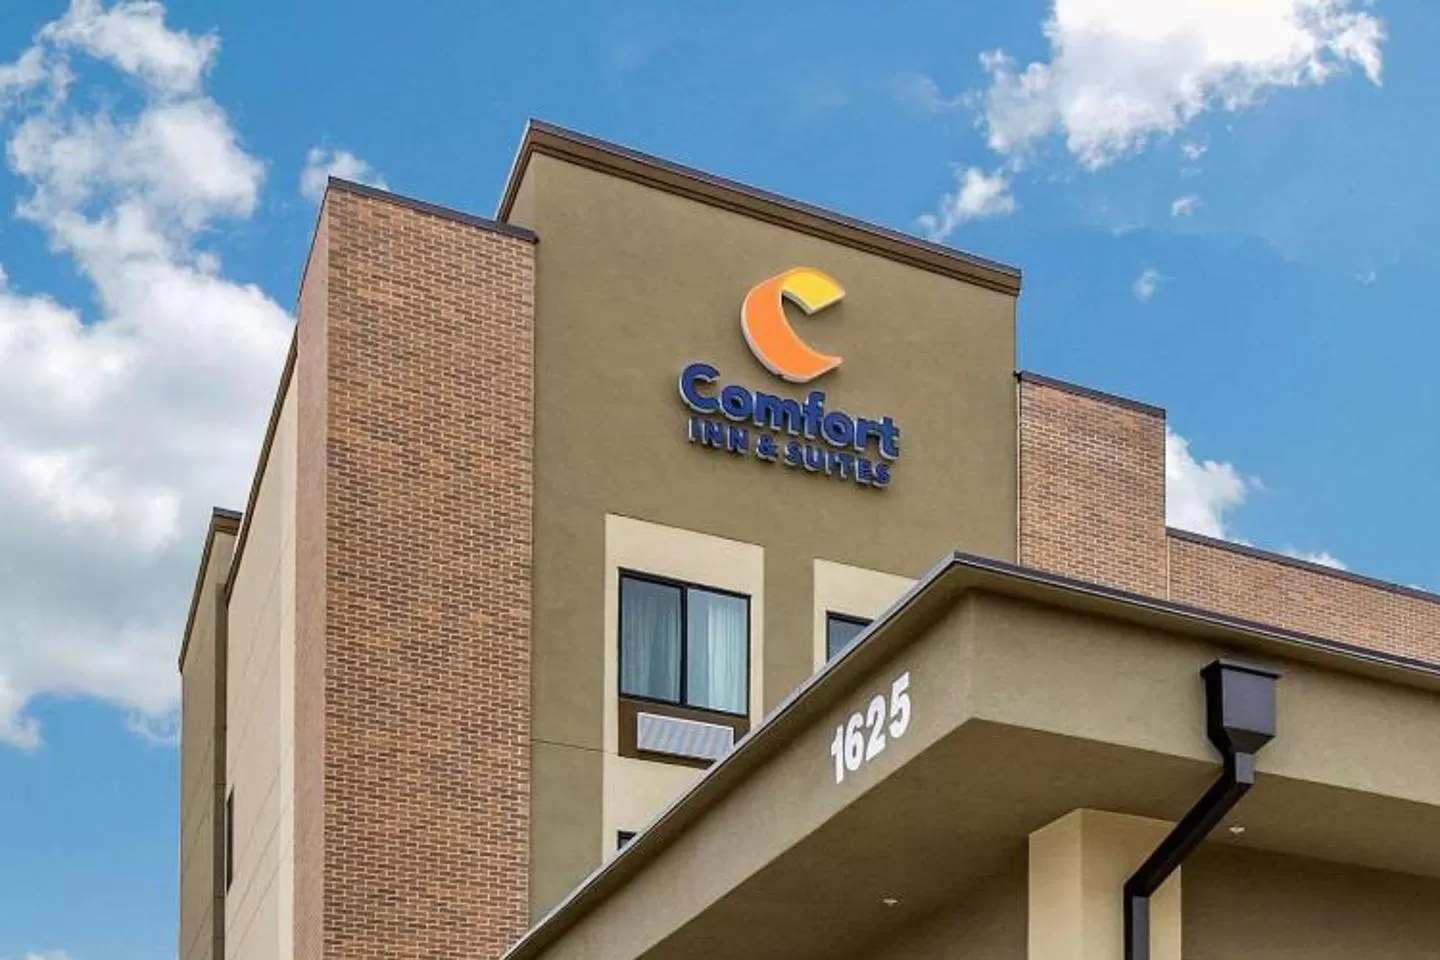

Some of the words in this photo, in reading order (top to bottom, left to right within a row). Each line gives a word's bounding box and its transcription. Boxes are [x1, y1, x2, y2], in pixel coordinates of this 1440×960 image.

[679, 361, 900, 460] Comfort
[688, 417, 749, 453] INN
[756, 434, 778, 462] &
[784, 440, 890, 487] SUITES
[831, 671, 911, 784] 1625
